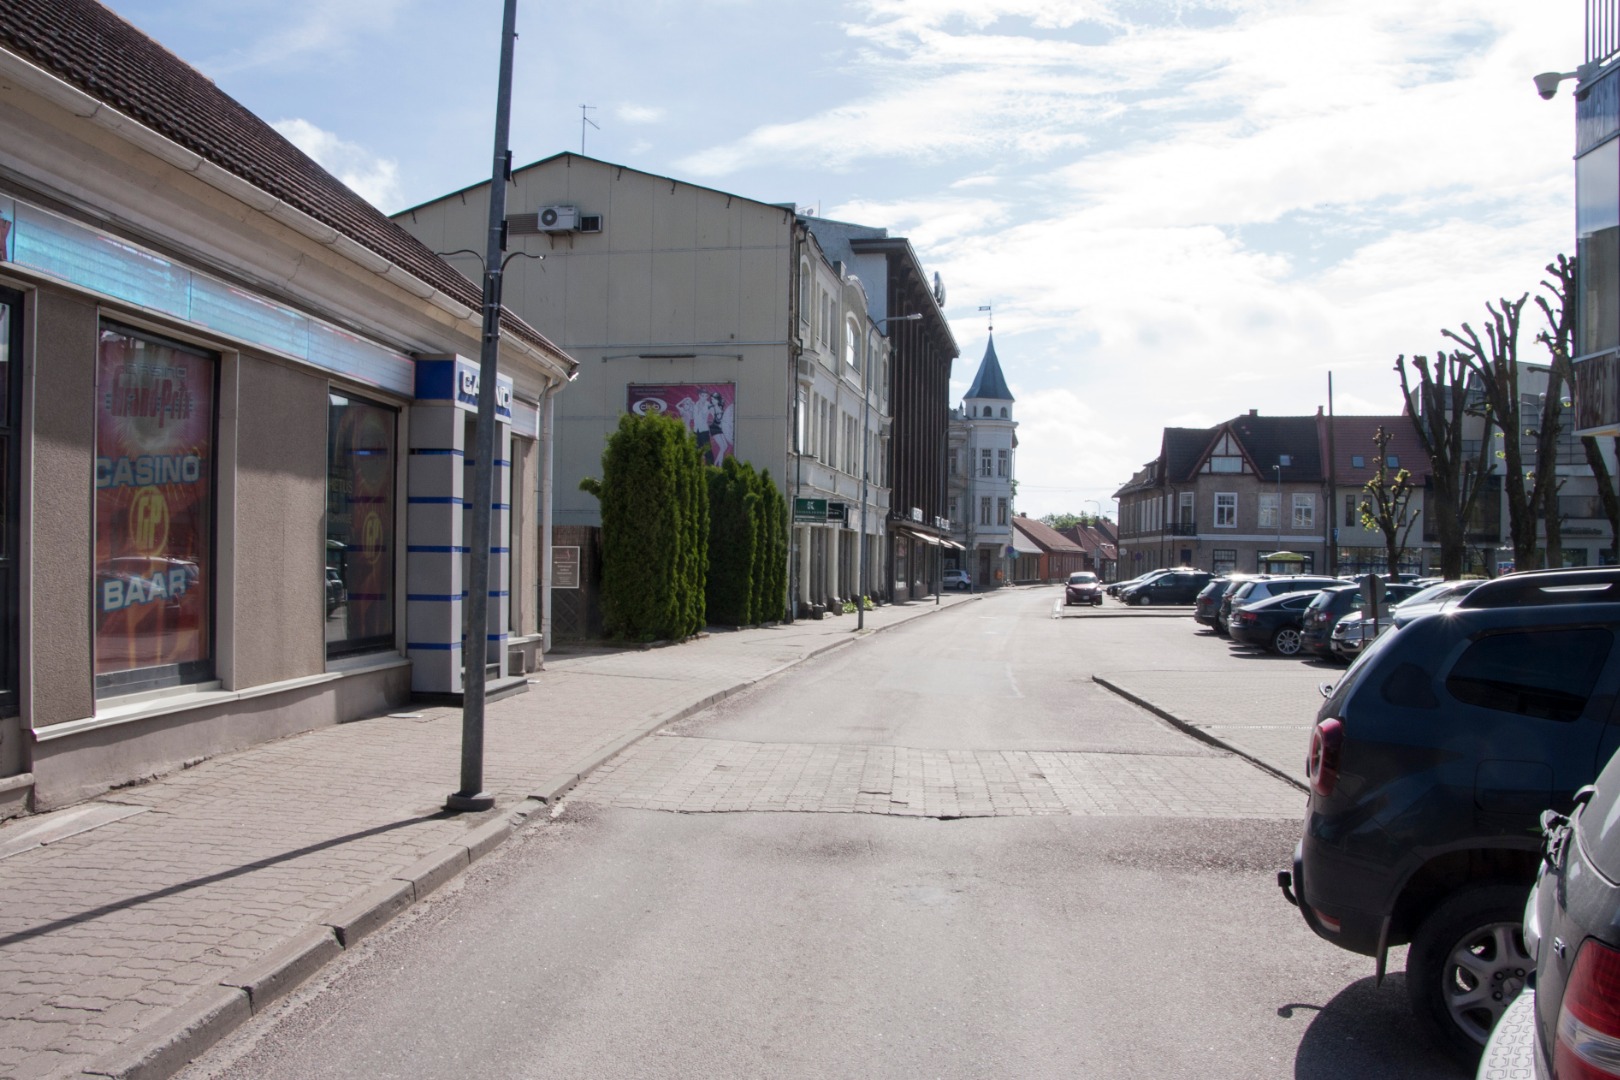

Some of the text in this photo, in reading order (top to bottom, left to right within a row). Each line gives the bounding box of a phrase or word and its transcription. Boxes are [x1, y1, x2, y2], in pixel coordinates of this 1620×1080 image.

[460, 369, 511, 409] CANO
[97, 455, 199, 487] CASINO
[104, 569, 186, 611] BAAR
